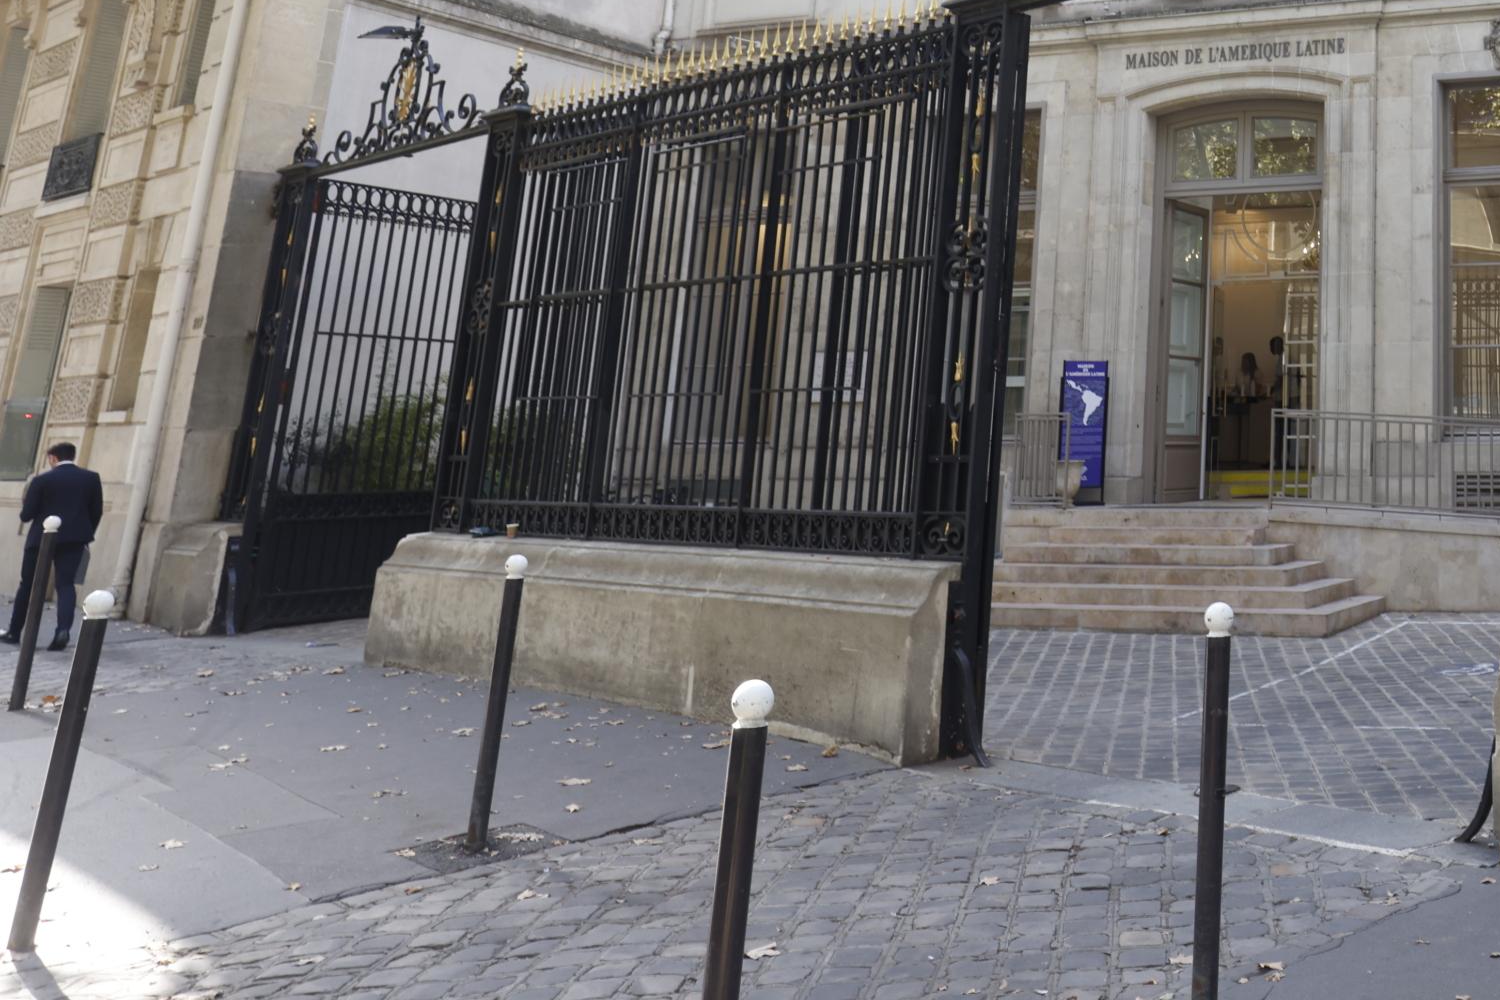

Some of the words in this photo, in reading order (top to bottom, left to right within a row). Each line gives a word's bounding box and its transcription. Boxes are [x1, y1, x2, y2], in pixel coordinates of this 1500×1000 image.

[1125, 50, 1179, 70] MAISON
[1185, 48, 1203, 65] DE
[1296, 38, 1345, 57] LATINE
